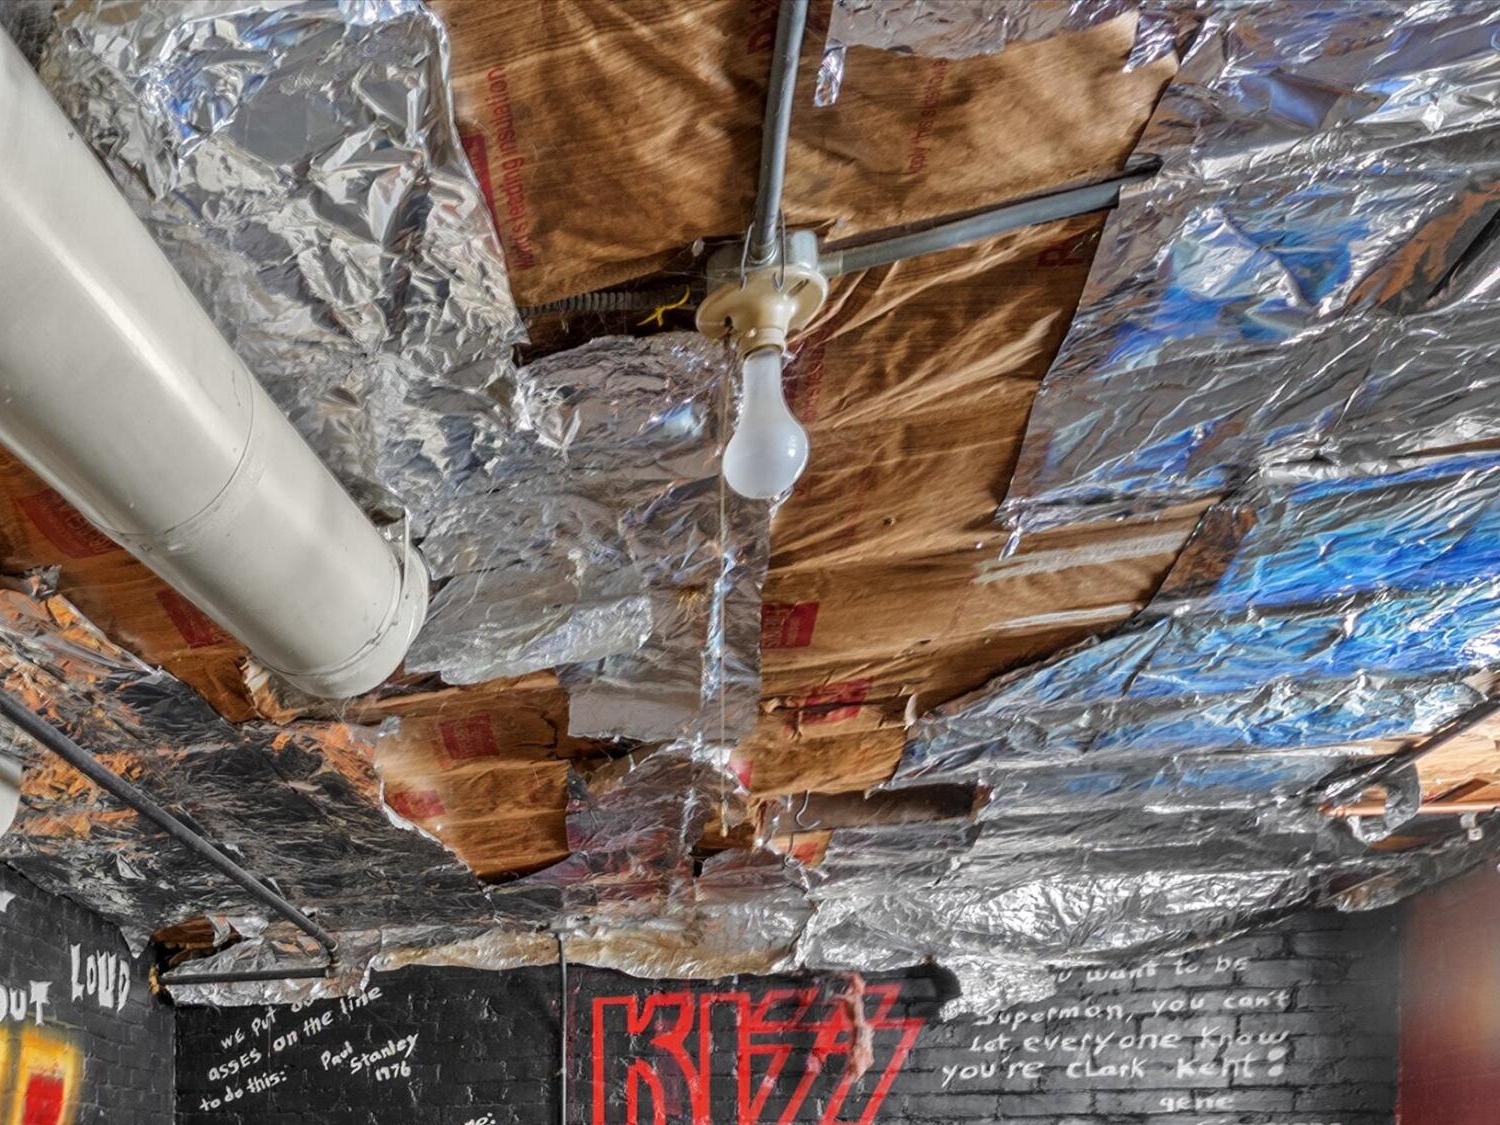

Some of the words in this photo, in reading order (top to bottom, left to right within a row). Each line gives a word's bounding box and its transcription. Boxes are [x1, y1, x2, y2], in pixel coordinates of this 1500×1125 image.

[69, 942, 132, 1014] LOUD
[1086, 960, 1161, 984] want
[1173, 957, 1199, 976] to
[1151, 997, 1205, 1019] you
[1222, 988, 1291, 1009] can't
[302, 1008, 335, 1038] the
[320, 1040, 353, 1072] Paul
[349, 1031, 420, 1075] Stanley
[1022, 1031, 1183, 1055] everyone
[374, 1060, 412, 1083] 1976
[940, 1055, 1046, 1089] you're
[198, 1093, 221, 1112] to
[223, 1085, 245, 1104] do
[246, 1070, 288, 1095] this:
